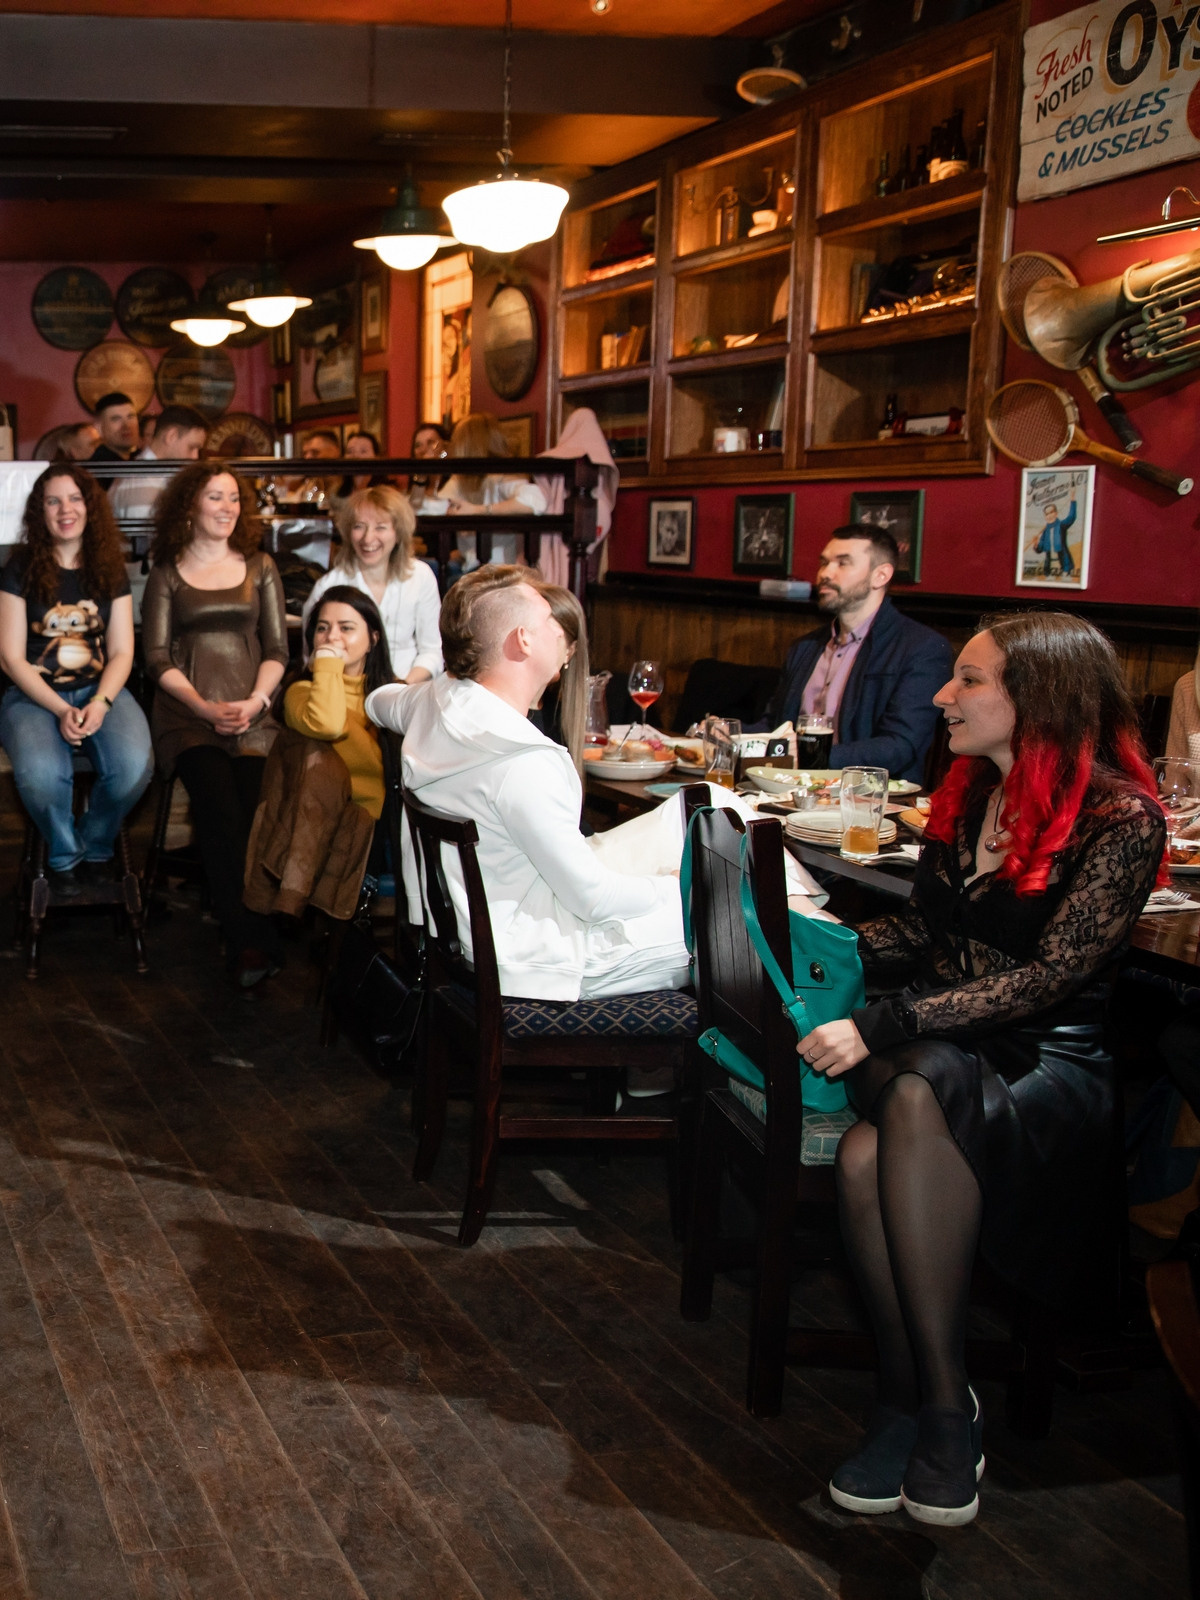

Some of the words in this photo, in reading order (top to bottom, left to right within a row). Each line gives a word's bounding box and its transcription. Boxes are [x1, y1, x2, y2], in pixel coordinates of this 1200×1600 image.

[1034, 14, 1100, 100] Fresh
[1035, 65, 1094, 124] NOTED
[1055, 87, 1171, 144] COCKLES
[1054, 118, 1174, 175] MUSSELS
